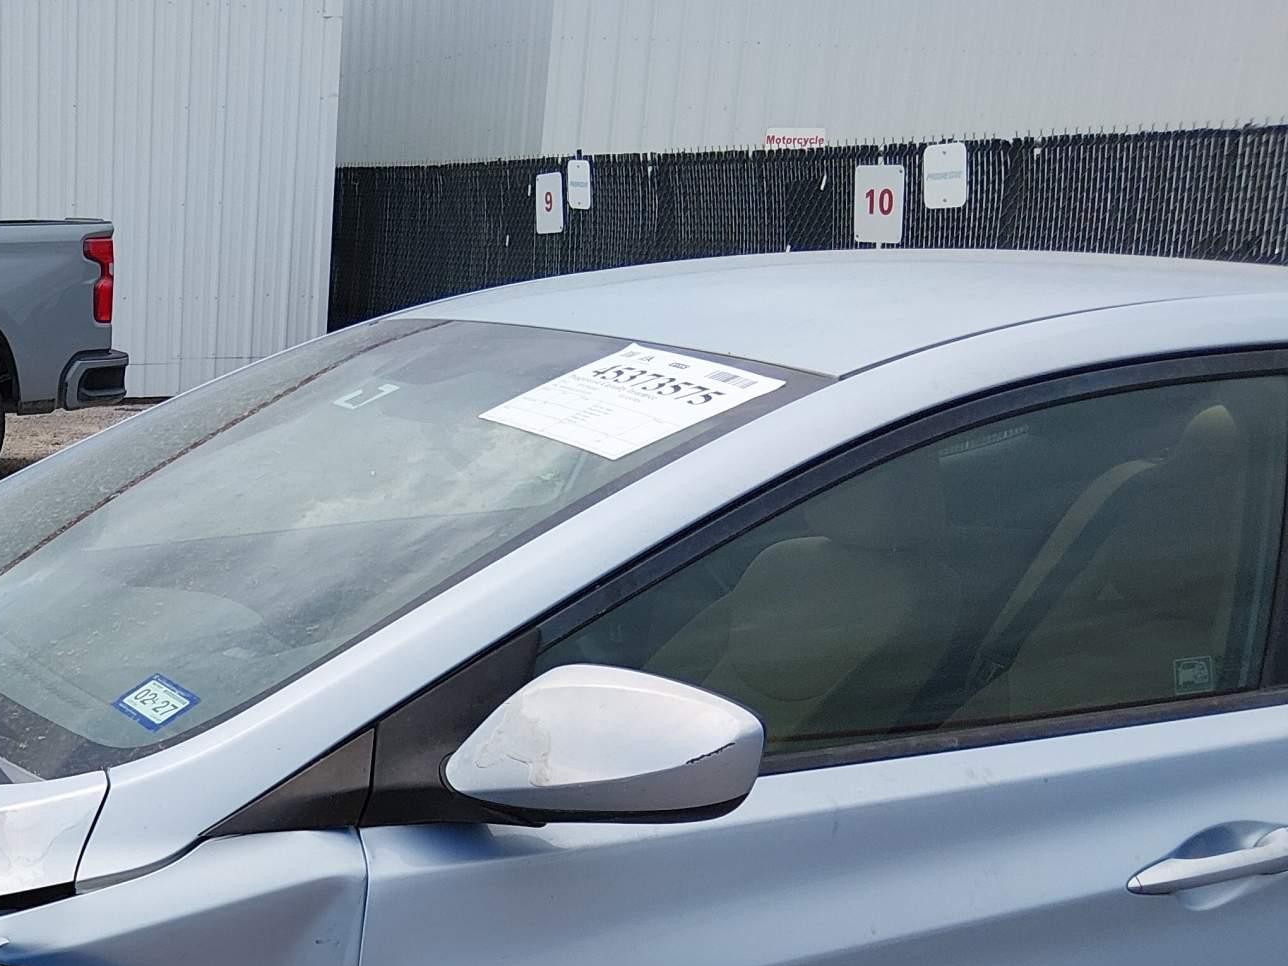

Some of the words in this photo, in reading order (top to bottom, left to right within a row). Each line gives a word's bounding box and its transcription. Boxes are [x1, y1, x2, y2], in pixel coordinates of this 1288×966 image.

[766, 135, 825, 147] Motorcycle
[544, 191, 553, 213] 9
[865, 188, 894, 216] 10
[592, 364, 727, 406] 45373575
